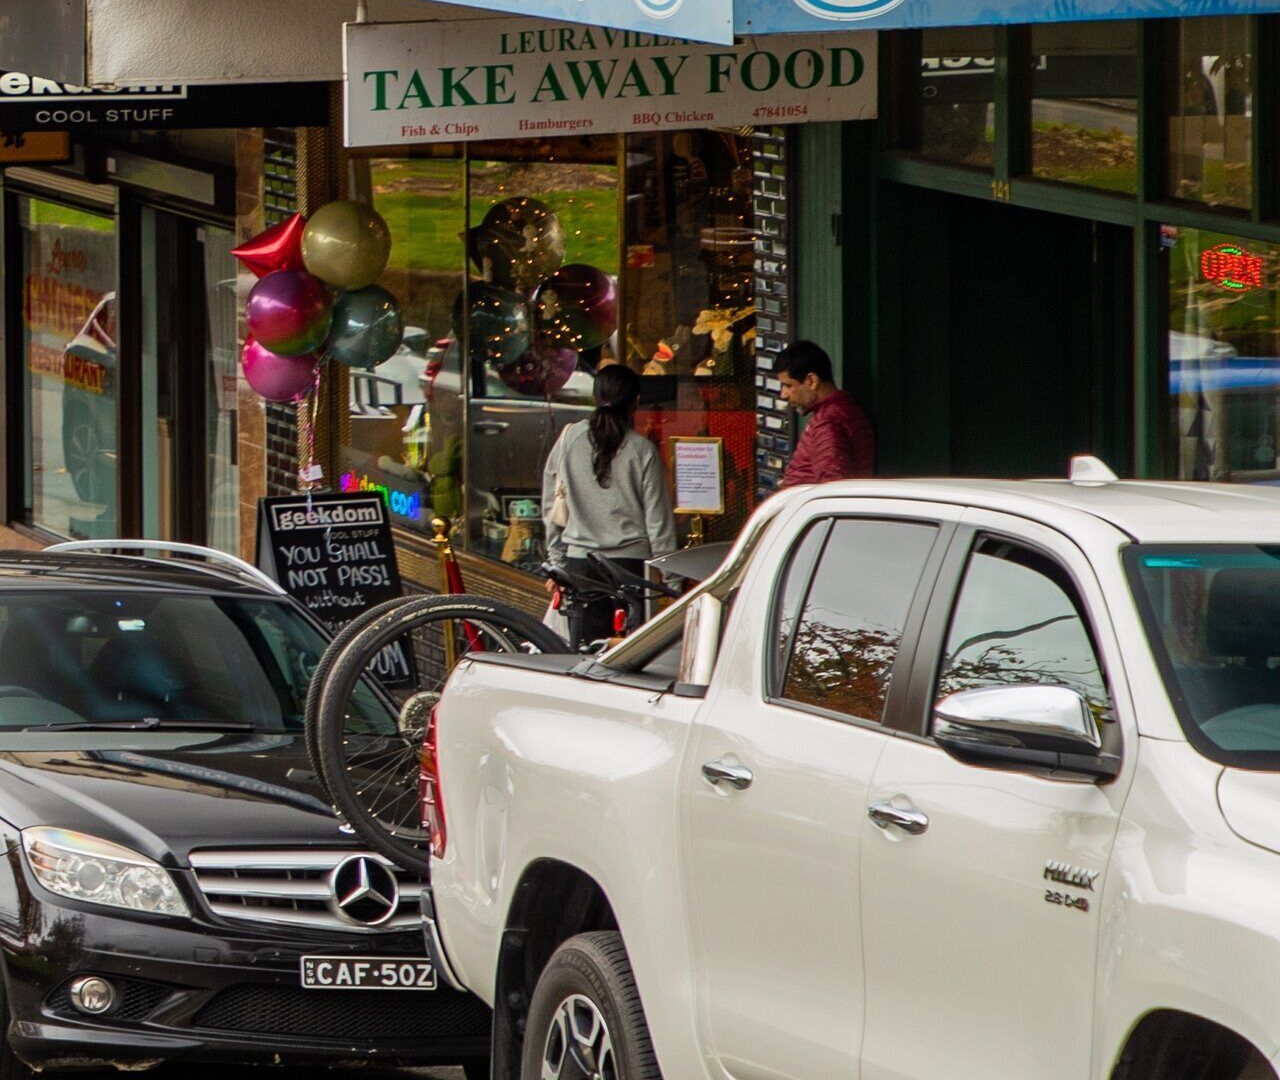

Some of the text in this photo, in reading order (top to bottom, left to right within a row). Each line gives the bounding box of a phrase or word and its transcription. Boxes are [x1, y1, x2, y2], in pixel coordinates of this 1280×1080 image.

[500, 27, 596, 56] LEURA
[363, 46, 867, 112] TAKE AWAY FOOD
[36, 108, 174, 124] COOL STUFF
[632, 110, 715, 126] BBQ Chicken
[752, 104, 809, 120] 47841054
[400, 123, 481, 139] Fish & Chips
[518, 117, 595, 133] Hamburgers
[279, 506, 378, 531] geekdom
[280, 540, 387, 566] YOU SHALL
[288, 564, 391, 589] NOT PASS!
[306, 590, 366, 609] without
